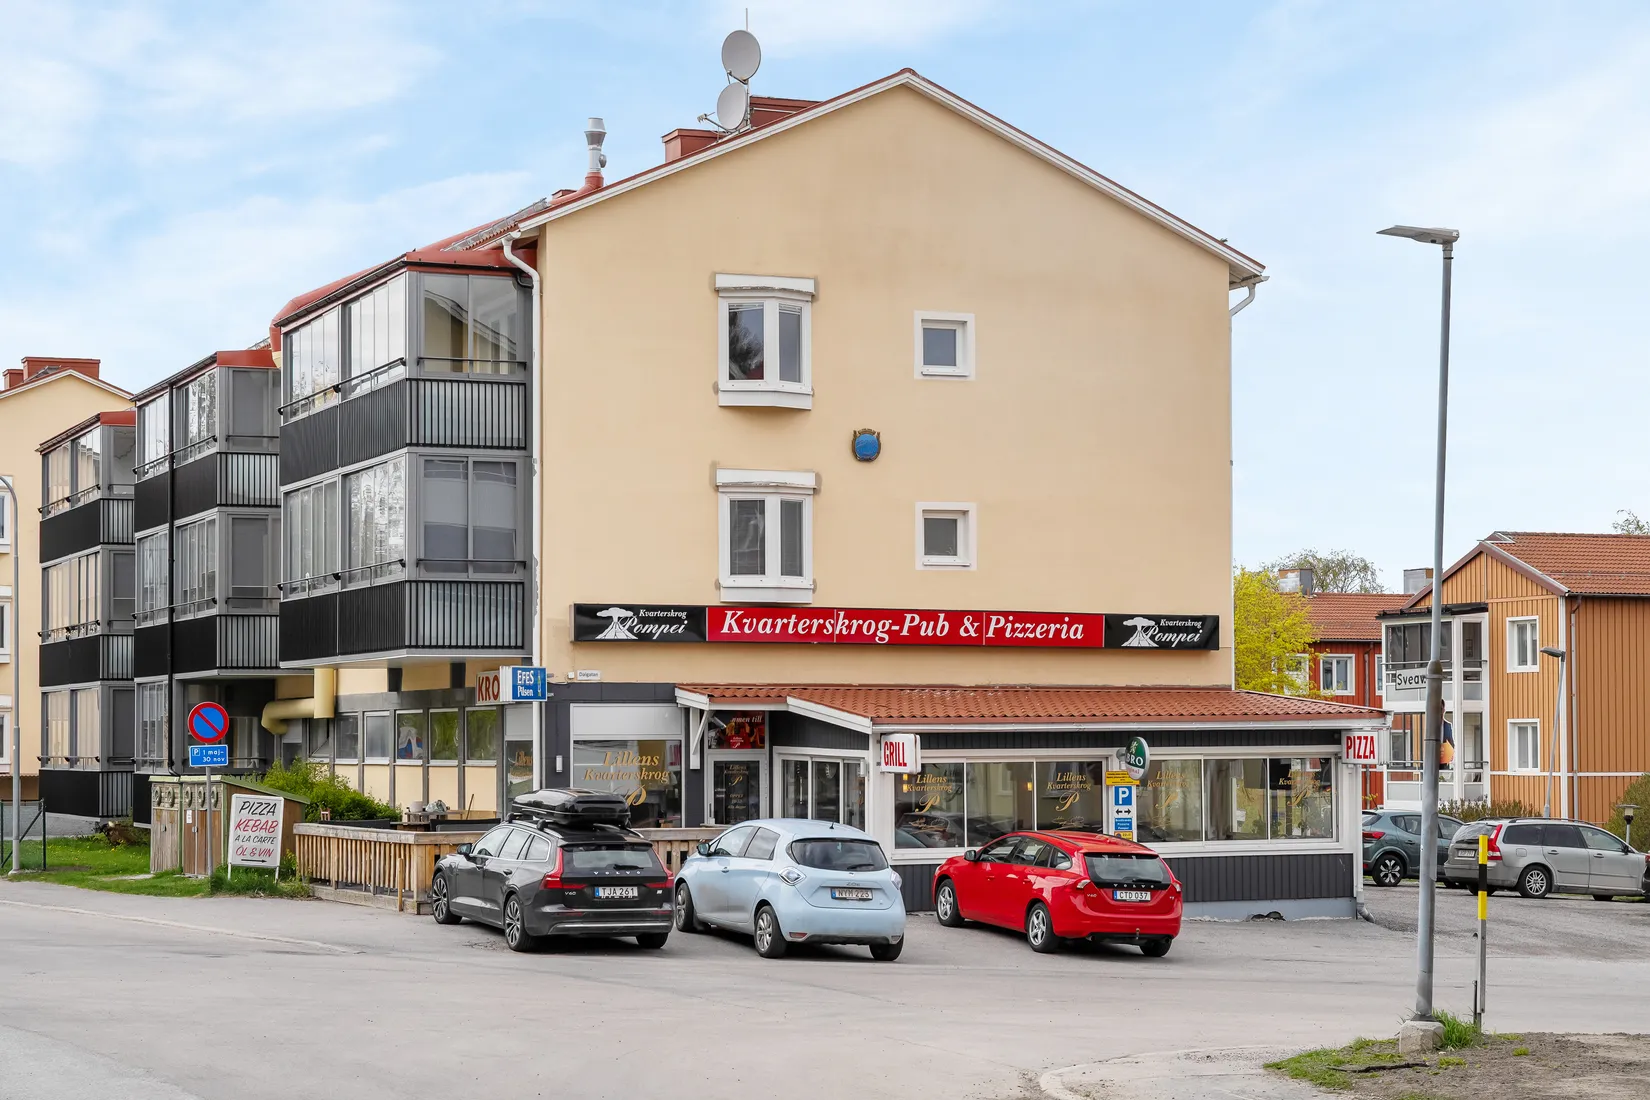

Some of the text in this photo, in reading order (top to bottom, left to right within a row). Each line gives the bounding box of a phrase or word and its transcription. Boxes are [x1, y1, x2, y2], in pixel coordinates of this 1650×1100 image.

[639, 609, 687, 620] Kvarterskrog
[619, 615, 688, 639] Pompei
[720, 610, 1085, 643] Kvarterskrog-Pub & Pizzeria
[1160, 619, 1202, 629] Kvarterskrog
[1142, 625, 1203, 647] Pompei
[517, 670, 534, 685] EFES
[477, 675, 500, 702] KRO
[517, 686, 534, 697] Pilsen
[1346, 735, 1376, 759] PIZZA
[602, 750, 660, 767] Lillens
[883, 741, 907, 767] GRILL
[1125, 753, 1144, 766] BRO
[584, 768, 670, 784] Kvarterskrog
[916, 774, 948, 784] Lillens
[1056, 772, 1086, 782] Lillens
[907, 784, 953, 793] Kvarterskrog
[1047, 782, 1092, 791] Kvarterskrog
[1118, 787, 1130, 805] P
[239, 801, 277, 816] PIZZA
[235, 819, 279, 833] KEBAB
[241, 835, 251, 843] LA
[252, 835, 277, 844] CARTE
[249, 847, 257, 857] &
[258, 848, 274, 857] VIN
[601, 887, 635, 896] TJA 261
[838, 889, 870, 898] NYM 223
[1119, 891, 1148, 900] CTD 037
